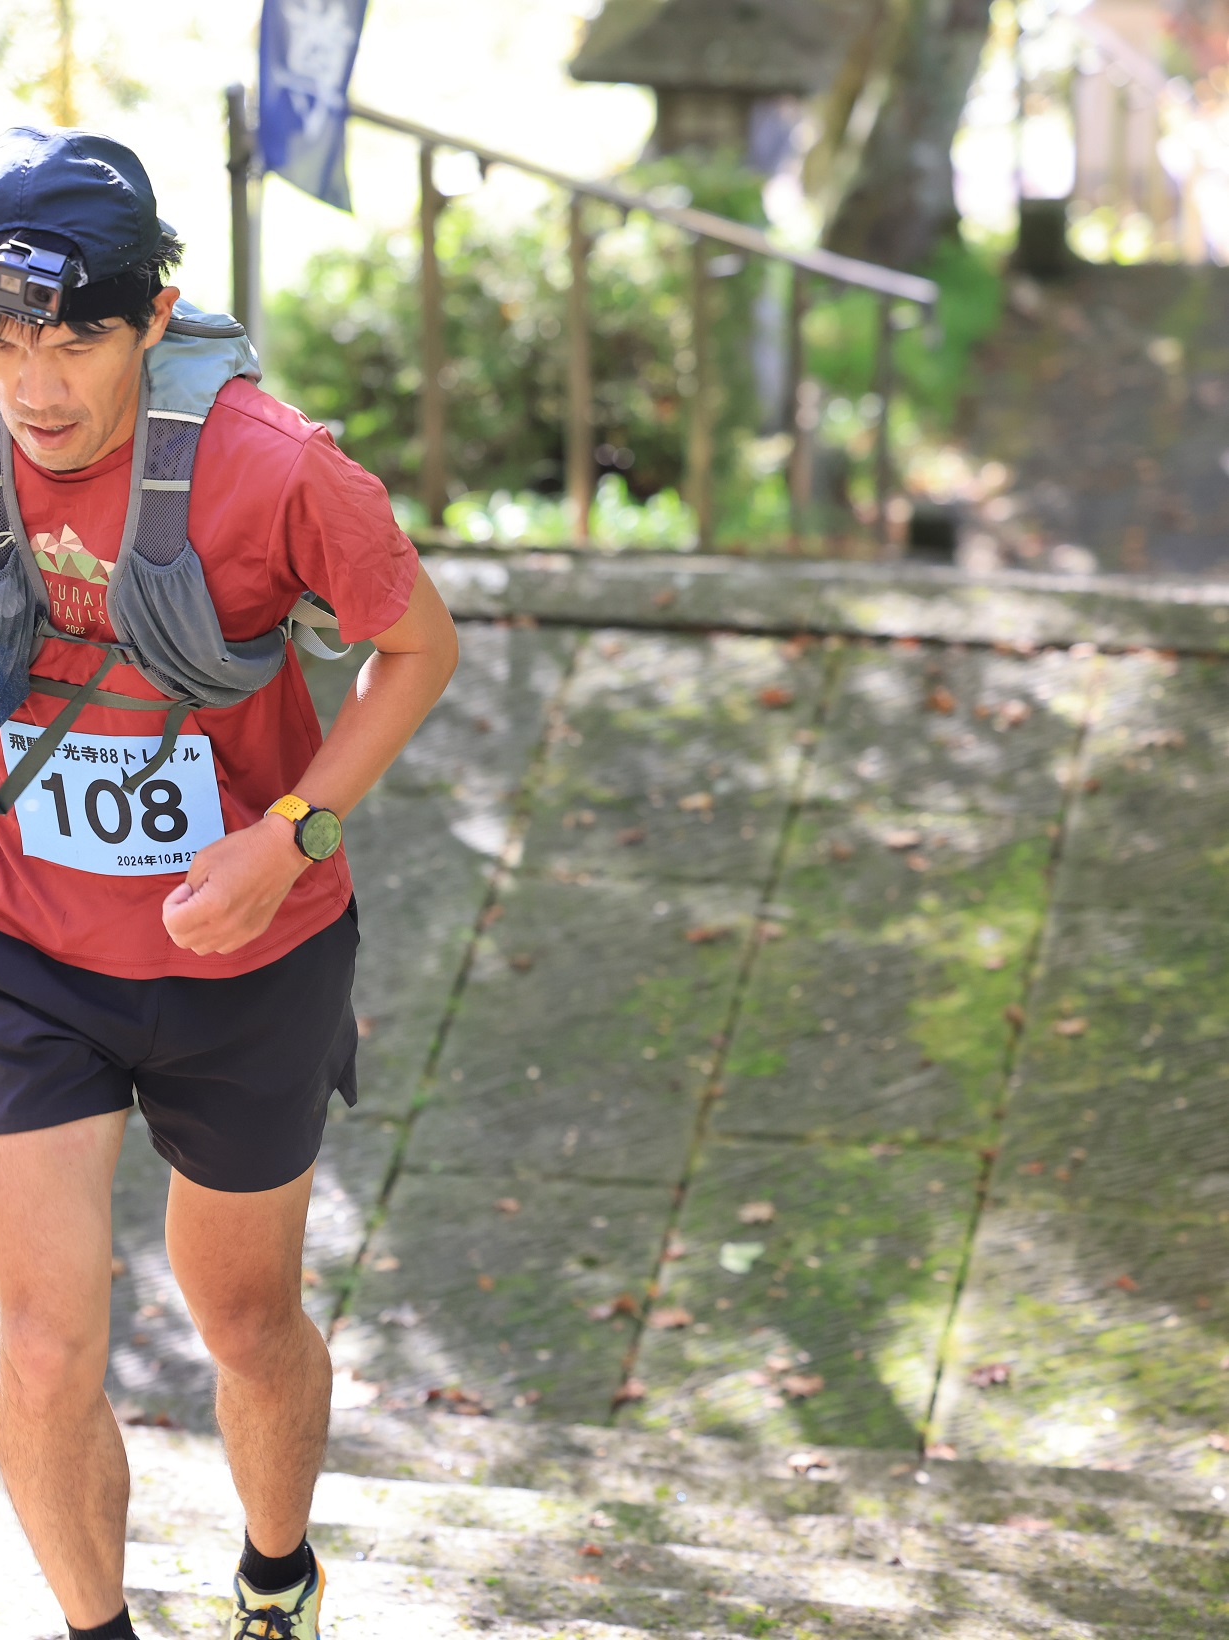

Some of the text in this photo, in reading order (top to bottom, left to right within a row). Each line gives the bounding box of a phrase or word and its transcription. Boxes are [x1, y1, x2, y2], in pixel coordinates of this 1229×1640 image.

[65, 624, 86, 635] 2022
[8, 732, 201, 765] 飛光寺88トレイル
[40, 772, 189, 845] 108
